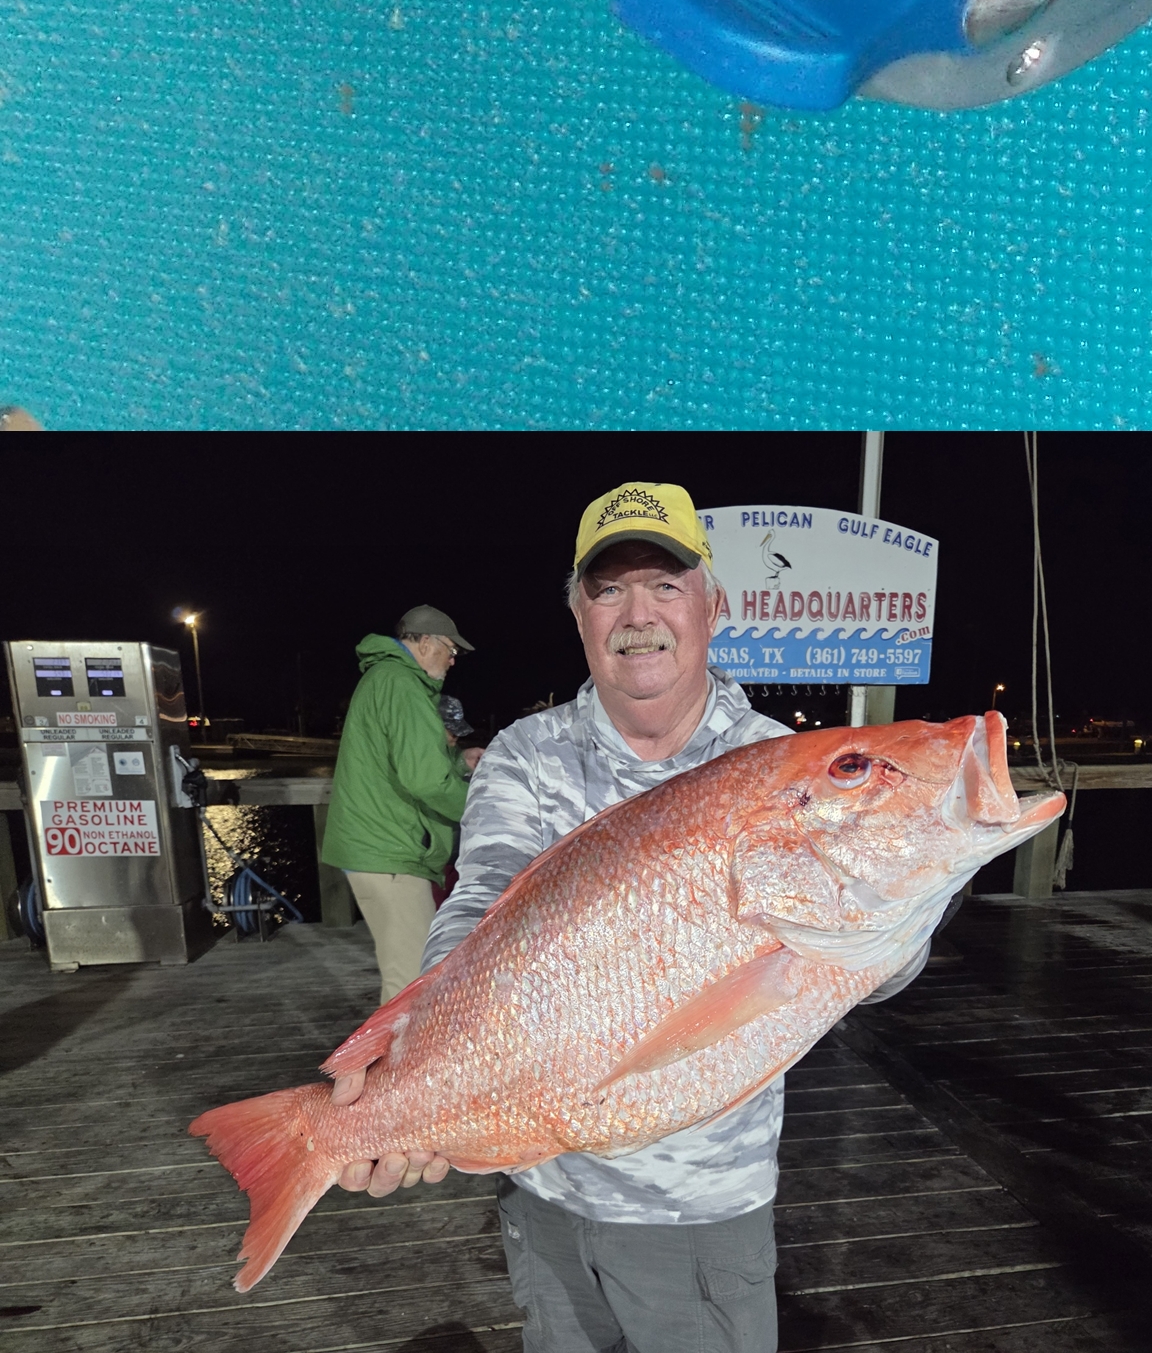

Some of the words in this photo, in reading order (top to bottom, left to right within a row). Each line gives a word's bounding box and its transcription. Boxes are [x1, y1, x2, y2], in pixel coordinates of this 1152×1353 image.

[623, 496, 655, 512] SHORE
[613, 509, 649, 519] TACKLE
[741, 511, 813, 529] PELICAN
[837, 517, 879, 540] GULF
[883, 528, 933, 558] EAGLE
[741, 590, 928, 623] HEADQUARTERS
[896, 625, 931, 644] .com
[762, 647, 785, 664] TX
[805, 646, 846, 666] (361)
[851, 648, 922, 665] 749-5597
[727, 668, 779, 678] MOUNTED
[790, 668, 833, 678] DETAILS
[837, 668, 849, 677] IN
[853, 668, 887, 678] STORE
[58, 714, 72, 724] NO
[74, 714, 116, 725] SMOKING
[53, 801, 143, 813] PREMIUM
[51, 814, 148, 826] GASOLINE
[46, 828, 81, 855] 90
[83, 831, 106, 839] NON
[108, 830, 157, 839] ETHANOL
[84, 841, 159, 855] OCTANE
